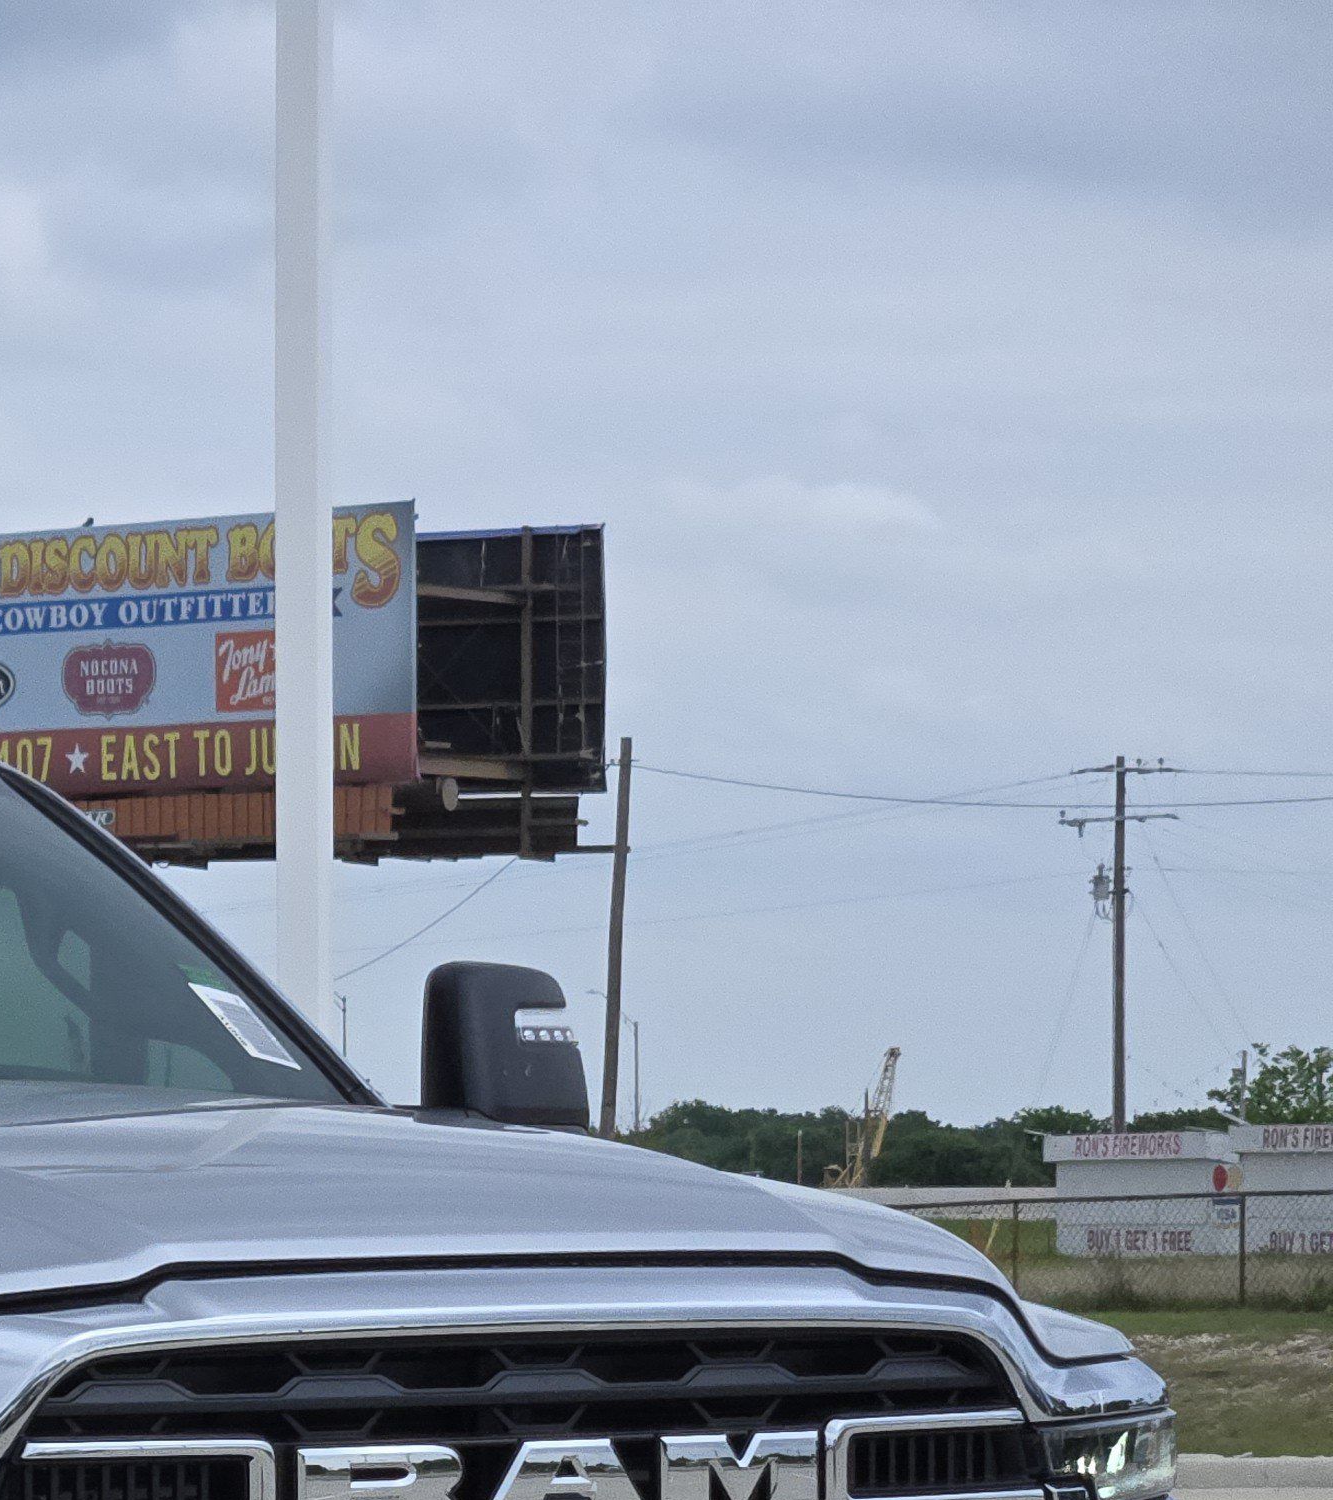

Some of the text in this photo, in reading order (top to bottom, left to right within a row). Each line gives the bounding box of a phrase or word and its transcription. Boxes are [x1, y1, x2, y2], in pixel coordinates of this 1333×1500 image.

[226, 510, 402, 609] BOTS
[79, 658, 139, 677] NOCONA
[218, 638, 269, 684] Tony
[86, 677, 134, 695] BOOTS
[229, 666, 275, 705] Lam
[100, 731, 181, 782] EAST
[193, 727, 232, 777] TO
[244, 723, 361, 776] JUN
[1113, 1133, 1182, 1157] FIREWORKS
[1263, 1126, 1299, 1149] RON'S
